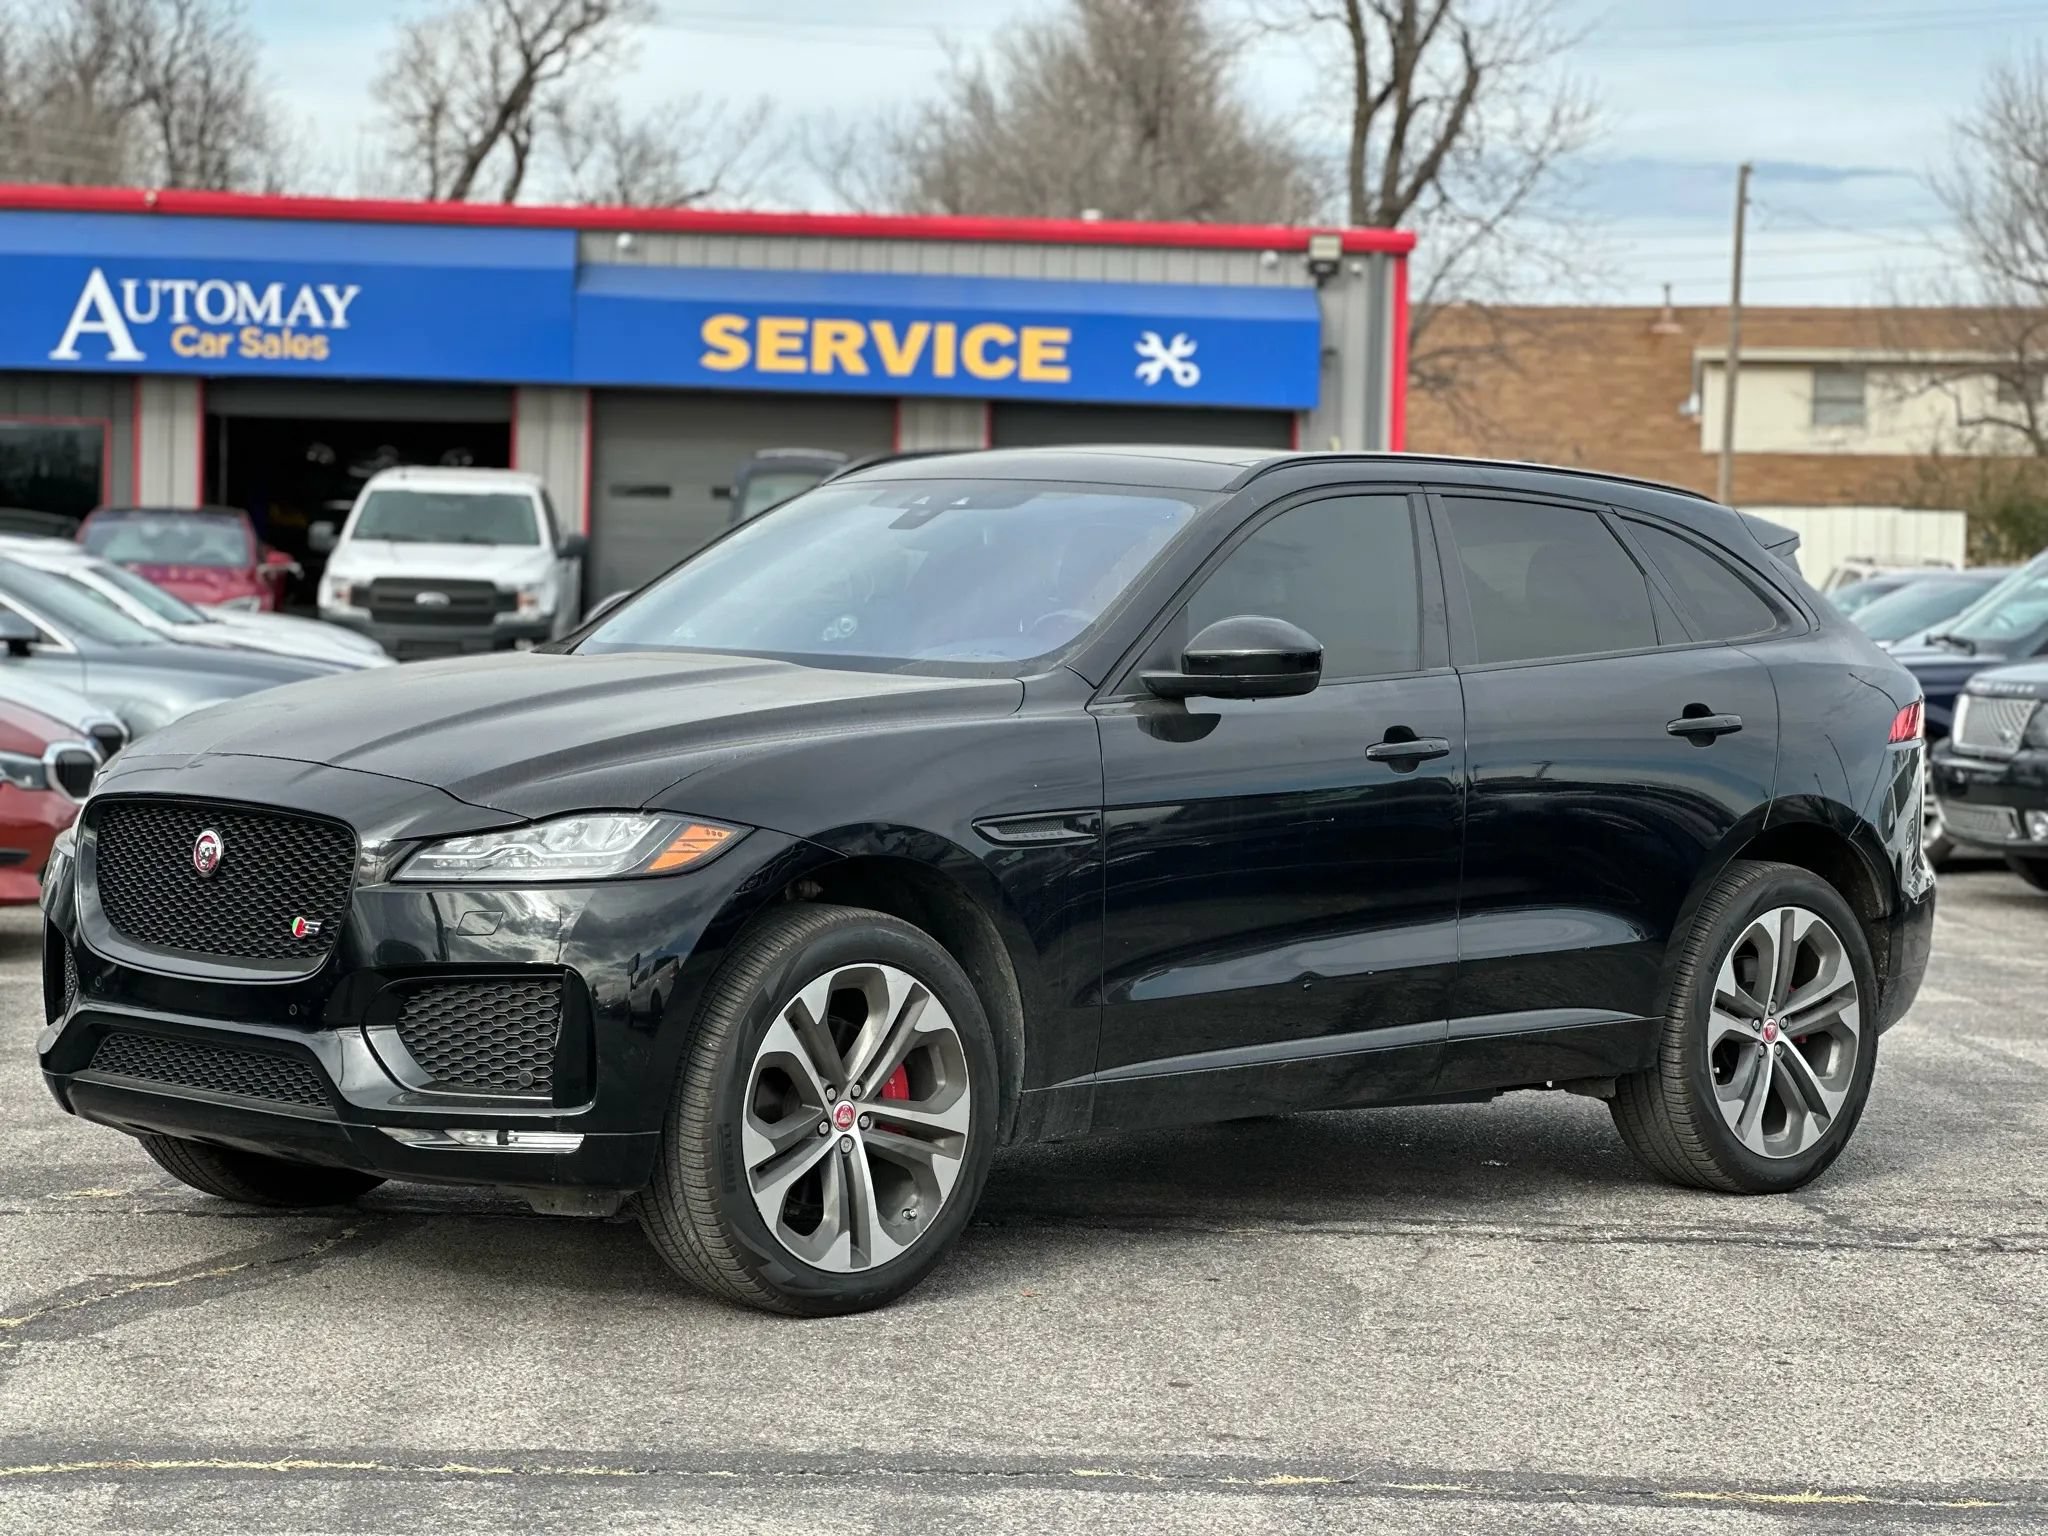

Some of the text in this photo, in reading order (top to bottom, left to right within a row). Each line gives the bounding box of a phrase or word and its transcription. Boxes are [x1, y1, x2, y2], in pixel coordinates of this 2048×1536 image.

[170, 325, 330, 361] Car Sales
[700, 313, 1071, 383] SERVICE
